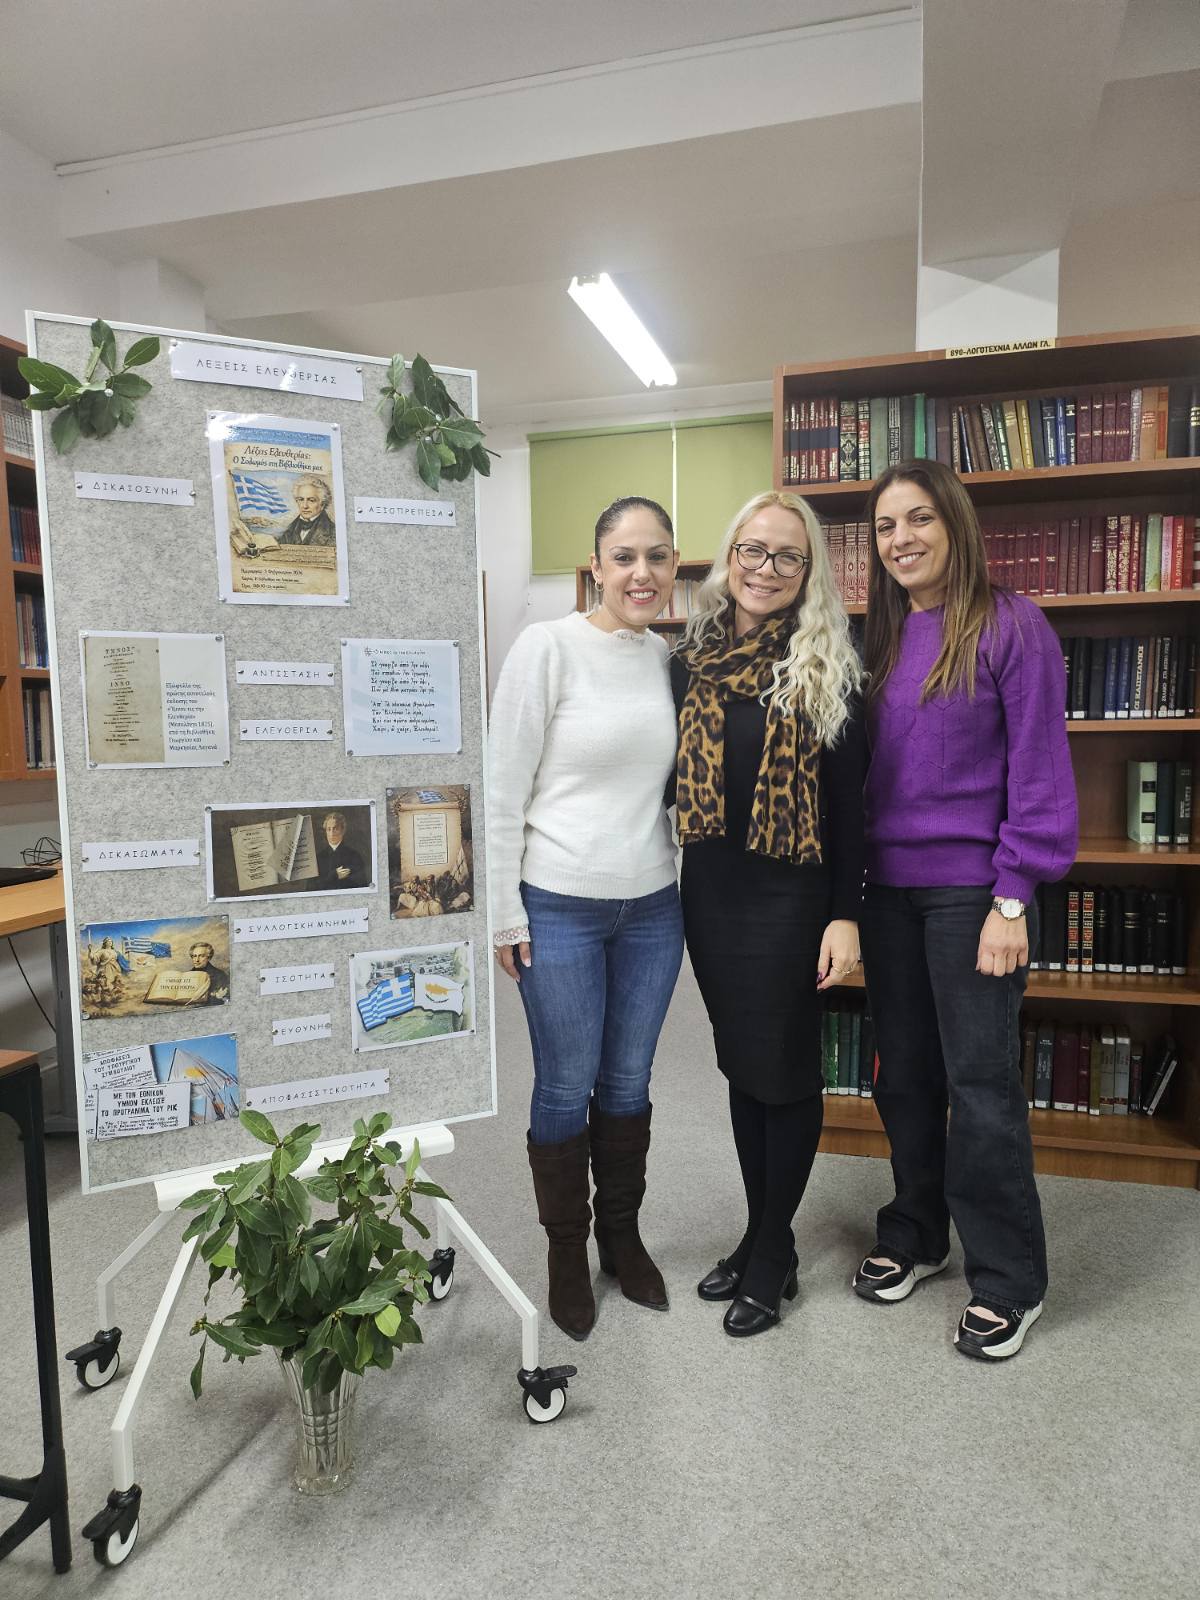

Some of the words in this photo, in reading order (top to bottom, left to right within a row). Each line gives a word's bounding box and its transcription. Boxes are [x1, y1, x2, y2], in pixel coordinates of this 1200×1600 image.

[950, 343, 1010, 356] 890-ΛΟΓΟΤΕΧΝΙΑ
[1013, 340, 1037, 351] ΑΛΛΩΝ
[196, 359, 248, 372] ΛΕΞΕΙΣ
[232, 456, 239, 464] Ο
[240, 457, 268, 467] Σολωμός
[279, 460, 312, 470] Βιβλιοθήκη
[93, 482, 178, 495] ΔΙΚΑΙΟΣΥΝΗ
[369, 506, 443, 517] ΑΞΙΟΠΡΕΠΕΙΑ
[253, 670, 320, 678] ΑΝΤΙΣΤΑΣΗ
[256, 726, 318, 735] ΕΛΕΥΘΕΡΙΑ
[99, 849, 183, 859] ΔΙΚΑΙΩΜΑΤΑ
[248, 922, 314, 933] ΣΥΛΛΟΓΙΚΗ
[316, 919, 356, 928] ΜΝΗΜΗ
[275, 972, 326, 983] ΙΣΟΤΗΤΑ
[281, 1024, 325, 1035] ΕΥΘΥΝΗ
[113, 1092, 122, 1100] ΜΕ
[140, 1090, 164, 1098] ΕΘΝΙΚΟΝ
[262, 1082, 376, 1105] ΑΠΟΦΑΣΙΣΤΙΚΟΤΗΤΑ
[113, 1108, 150, 1117] ΠΡΟΓΡΑΜΜΑ
[153, 1105, 164, 1113] ΤΟΥ
[166, 1104, 178, 1112] ΡΙΚ
